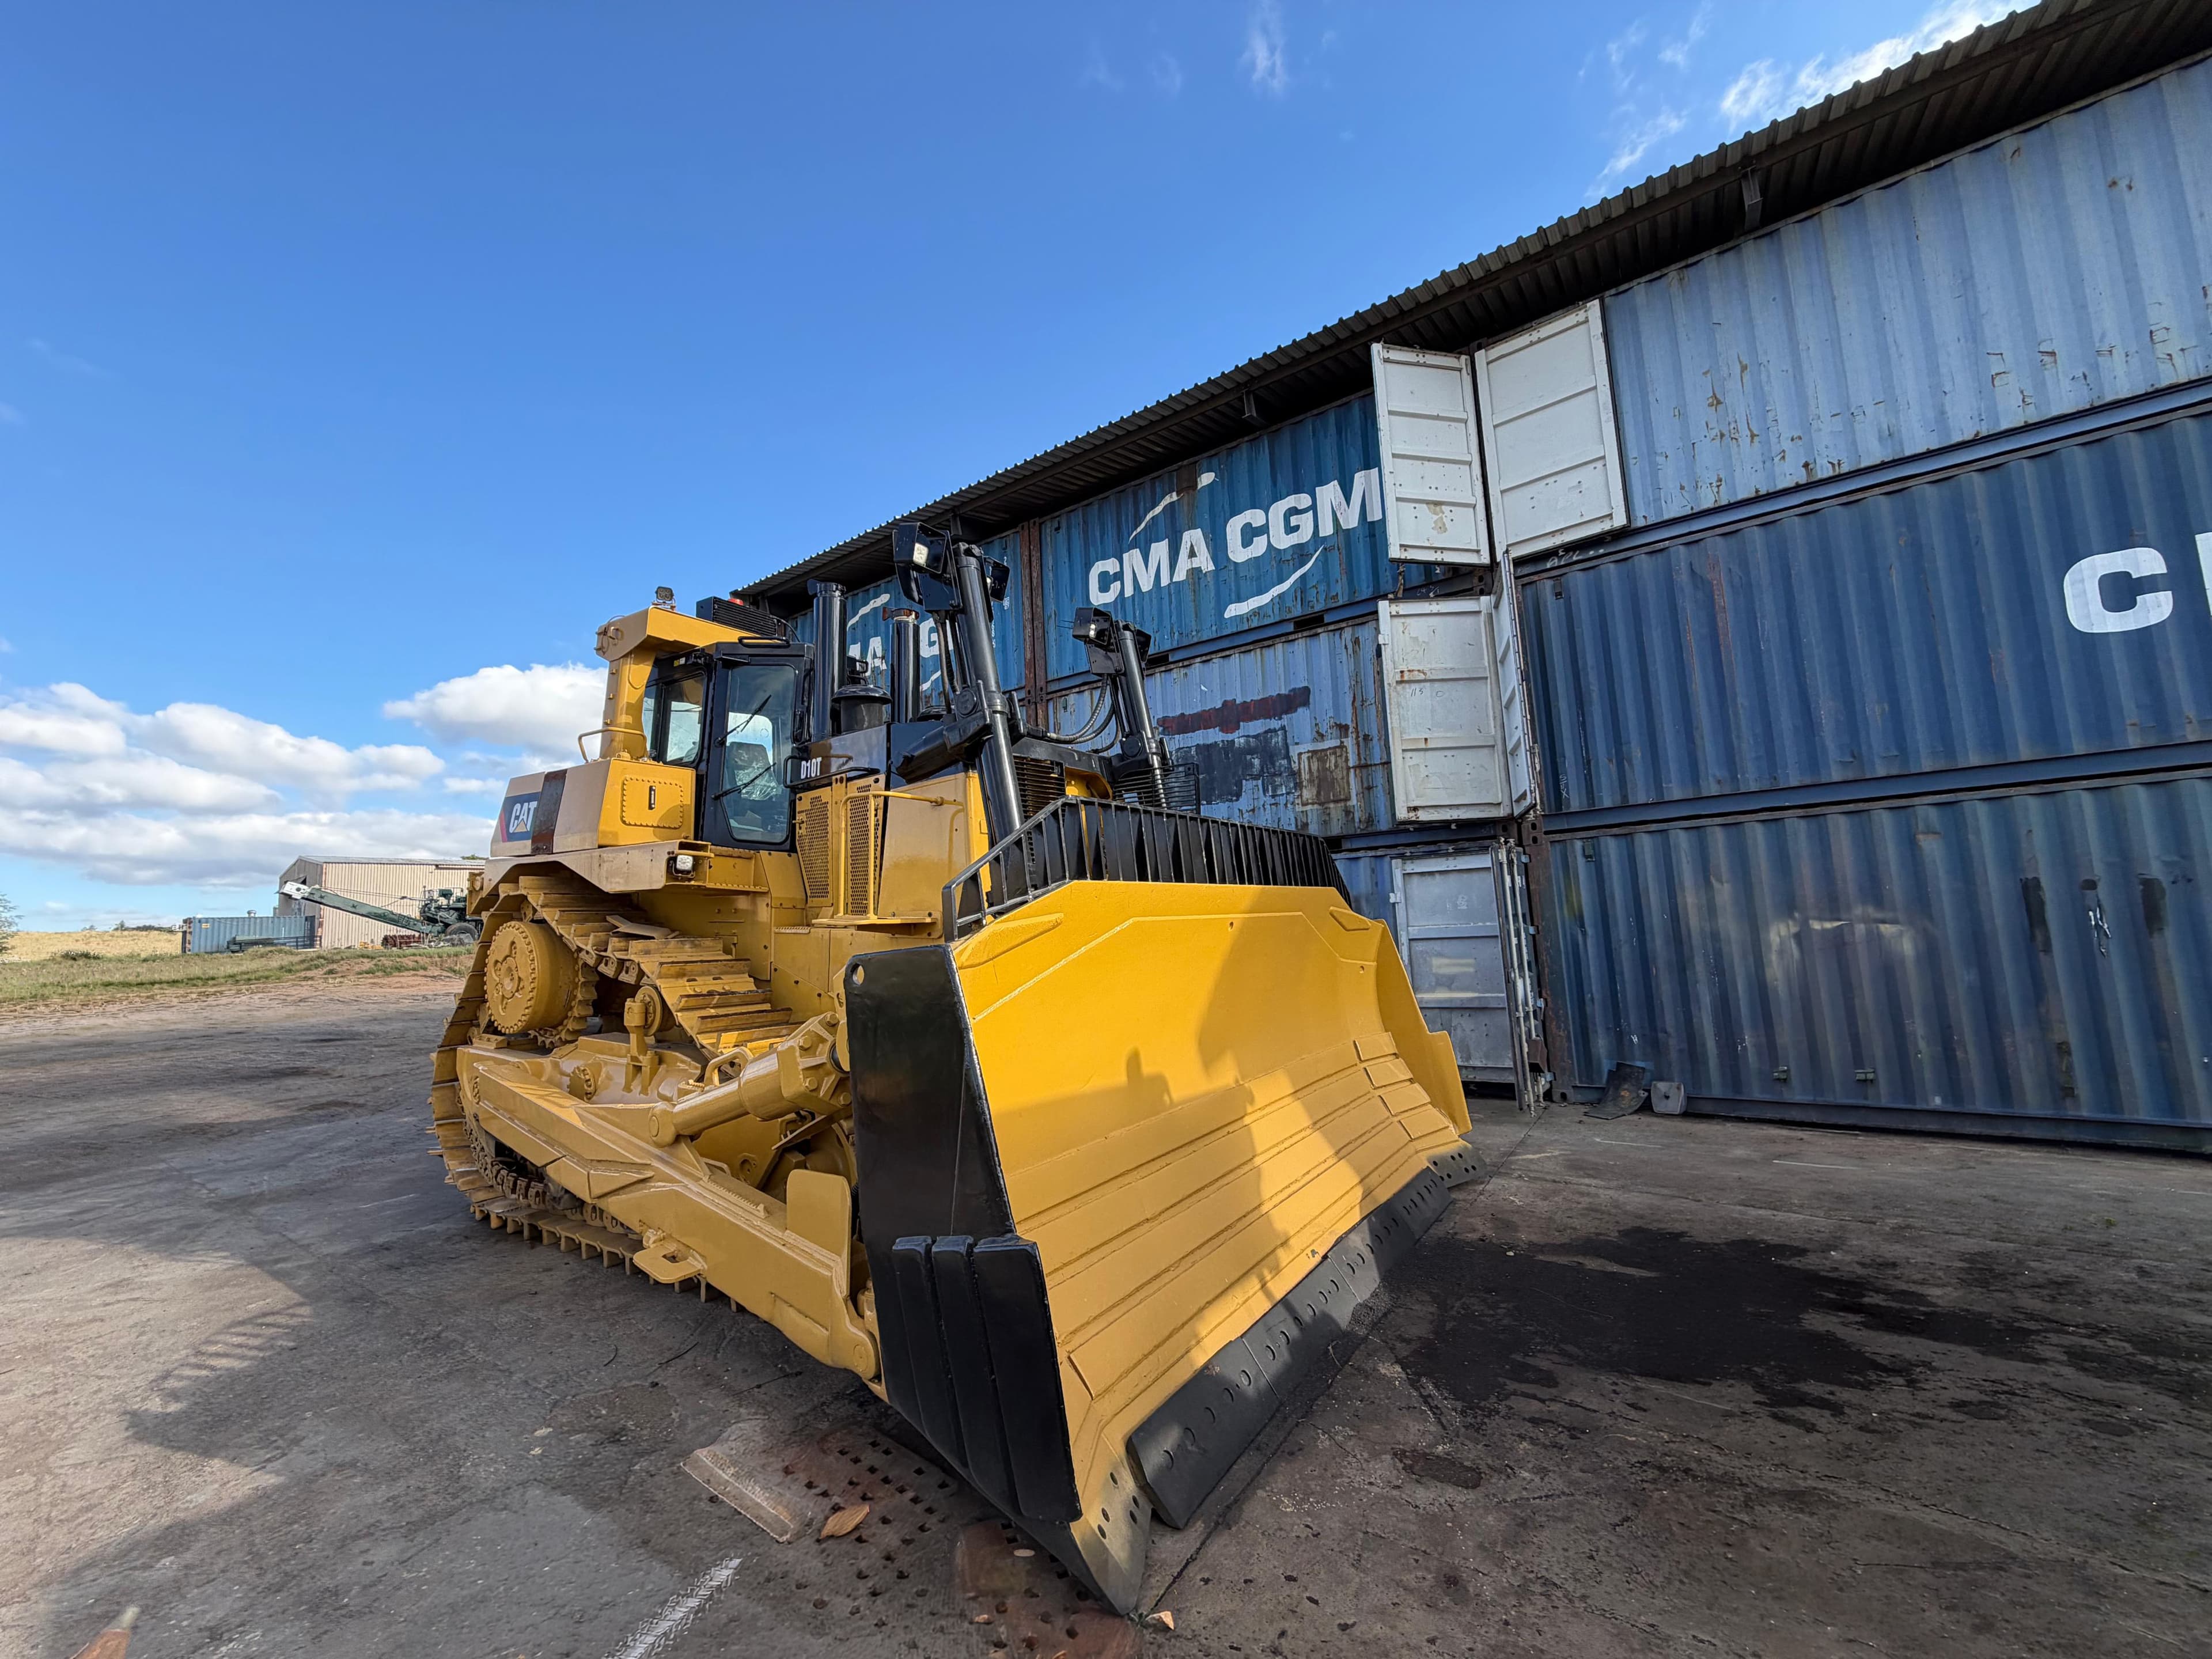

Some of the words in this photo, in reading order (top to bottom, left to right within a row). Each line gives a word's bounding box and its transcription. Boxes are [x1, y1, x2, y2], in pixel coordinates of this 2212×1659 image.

[1089, 528, 1215, 605] CMA
[1226, 468, 1382, 563] CGM
[2063, 532, 2212, 632] C
[801, 757, 822, 779] D10T
[509, 801, 537, 833] CAT
